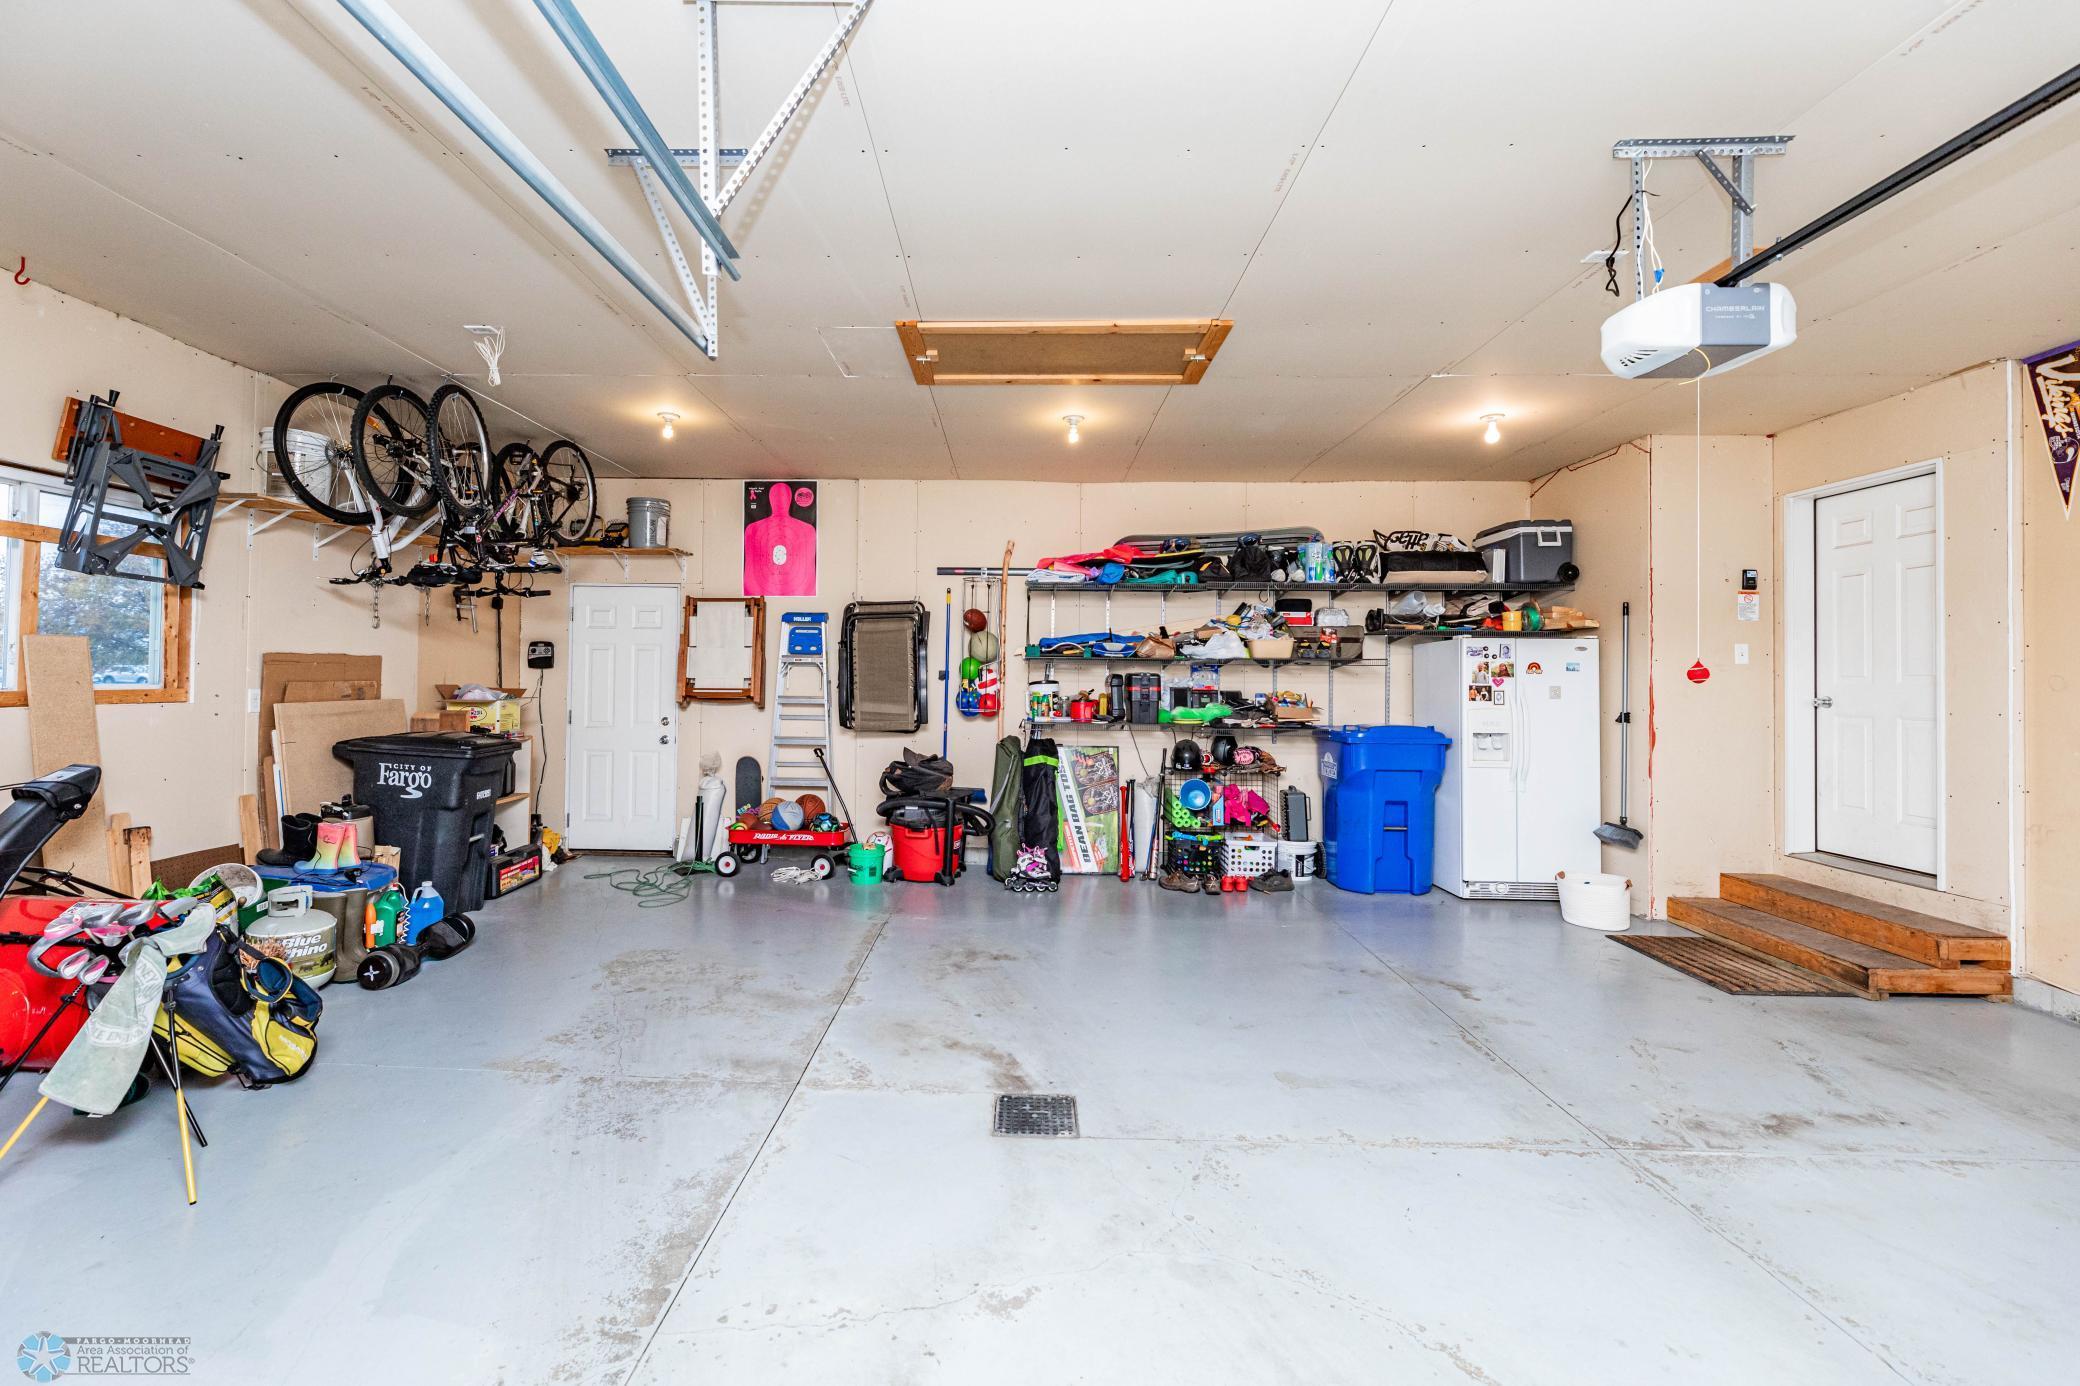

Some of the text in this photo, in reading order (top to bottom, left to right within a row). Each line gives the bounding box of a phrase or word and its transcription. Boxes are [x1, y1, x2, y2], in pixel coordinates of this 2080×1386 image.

[2035, 353, 2080, 439] Vikings
[376, 762, 432, 799] Fargo
[393, 763, 416, 771] CITY
[1066, 794, 1080, 824] BAG
[1074, 825, 1092, 864] BEAN
[282, 934, 322, 949] Blue
